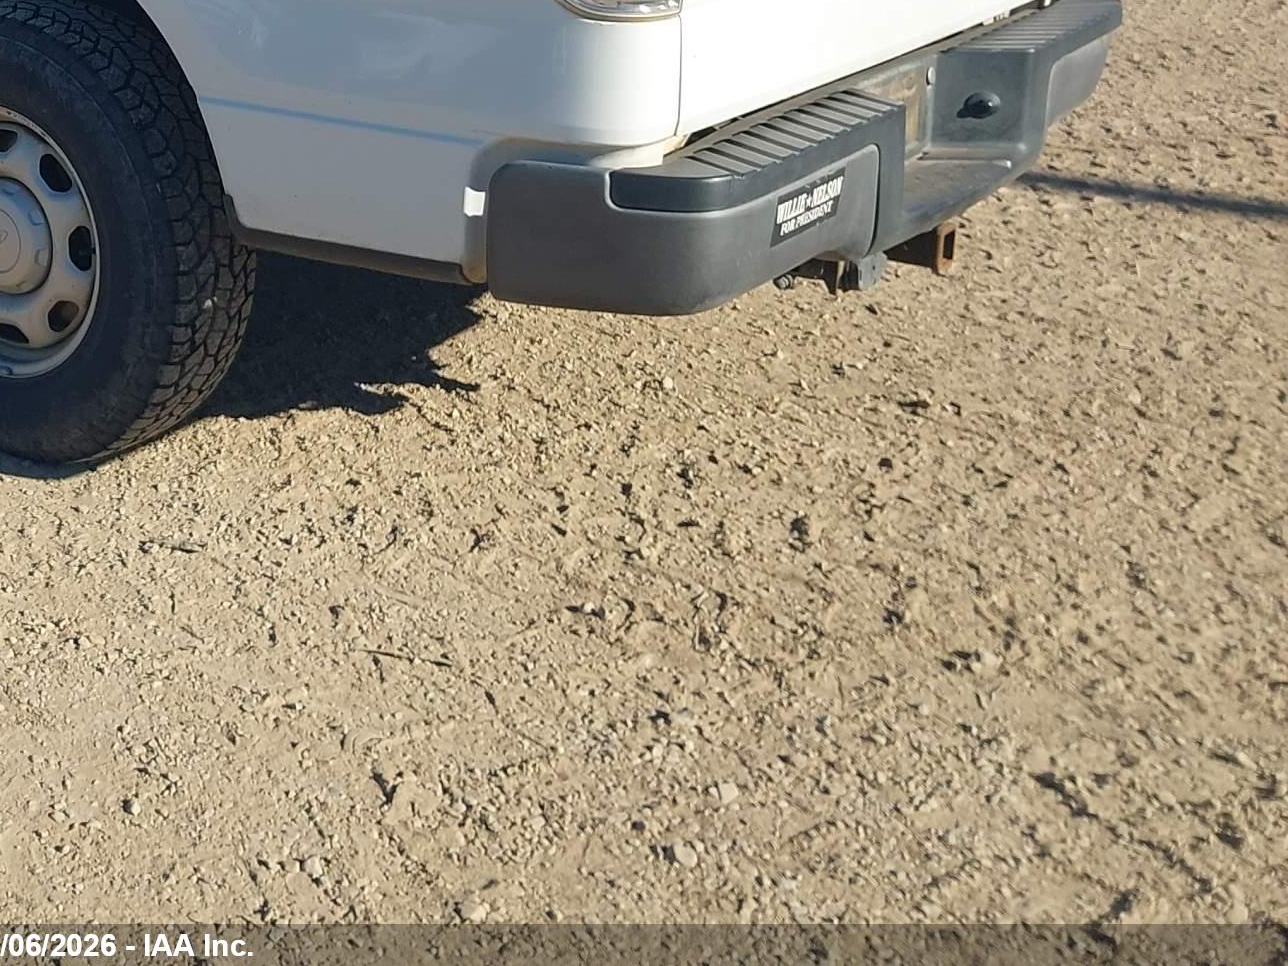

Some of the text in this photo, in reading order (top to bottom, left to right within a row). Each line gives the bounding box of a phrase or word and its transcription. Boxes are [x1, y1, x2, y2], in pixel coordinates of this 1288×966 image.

[776, 175, 844, 225] WILLIE NELSON
[780, 199, 834, 236] FOR PRESIDENT
